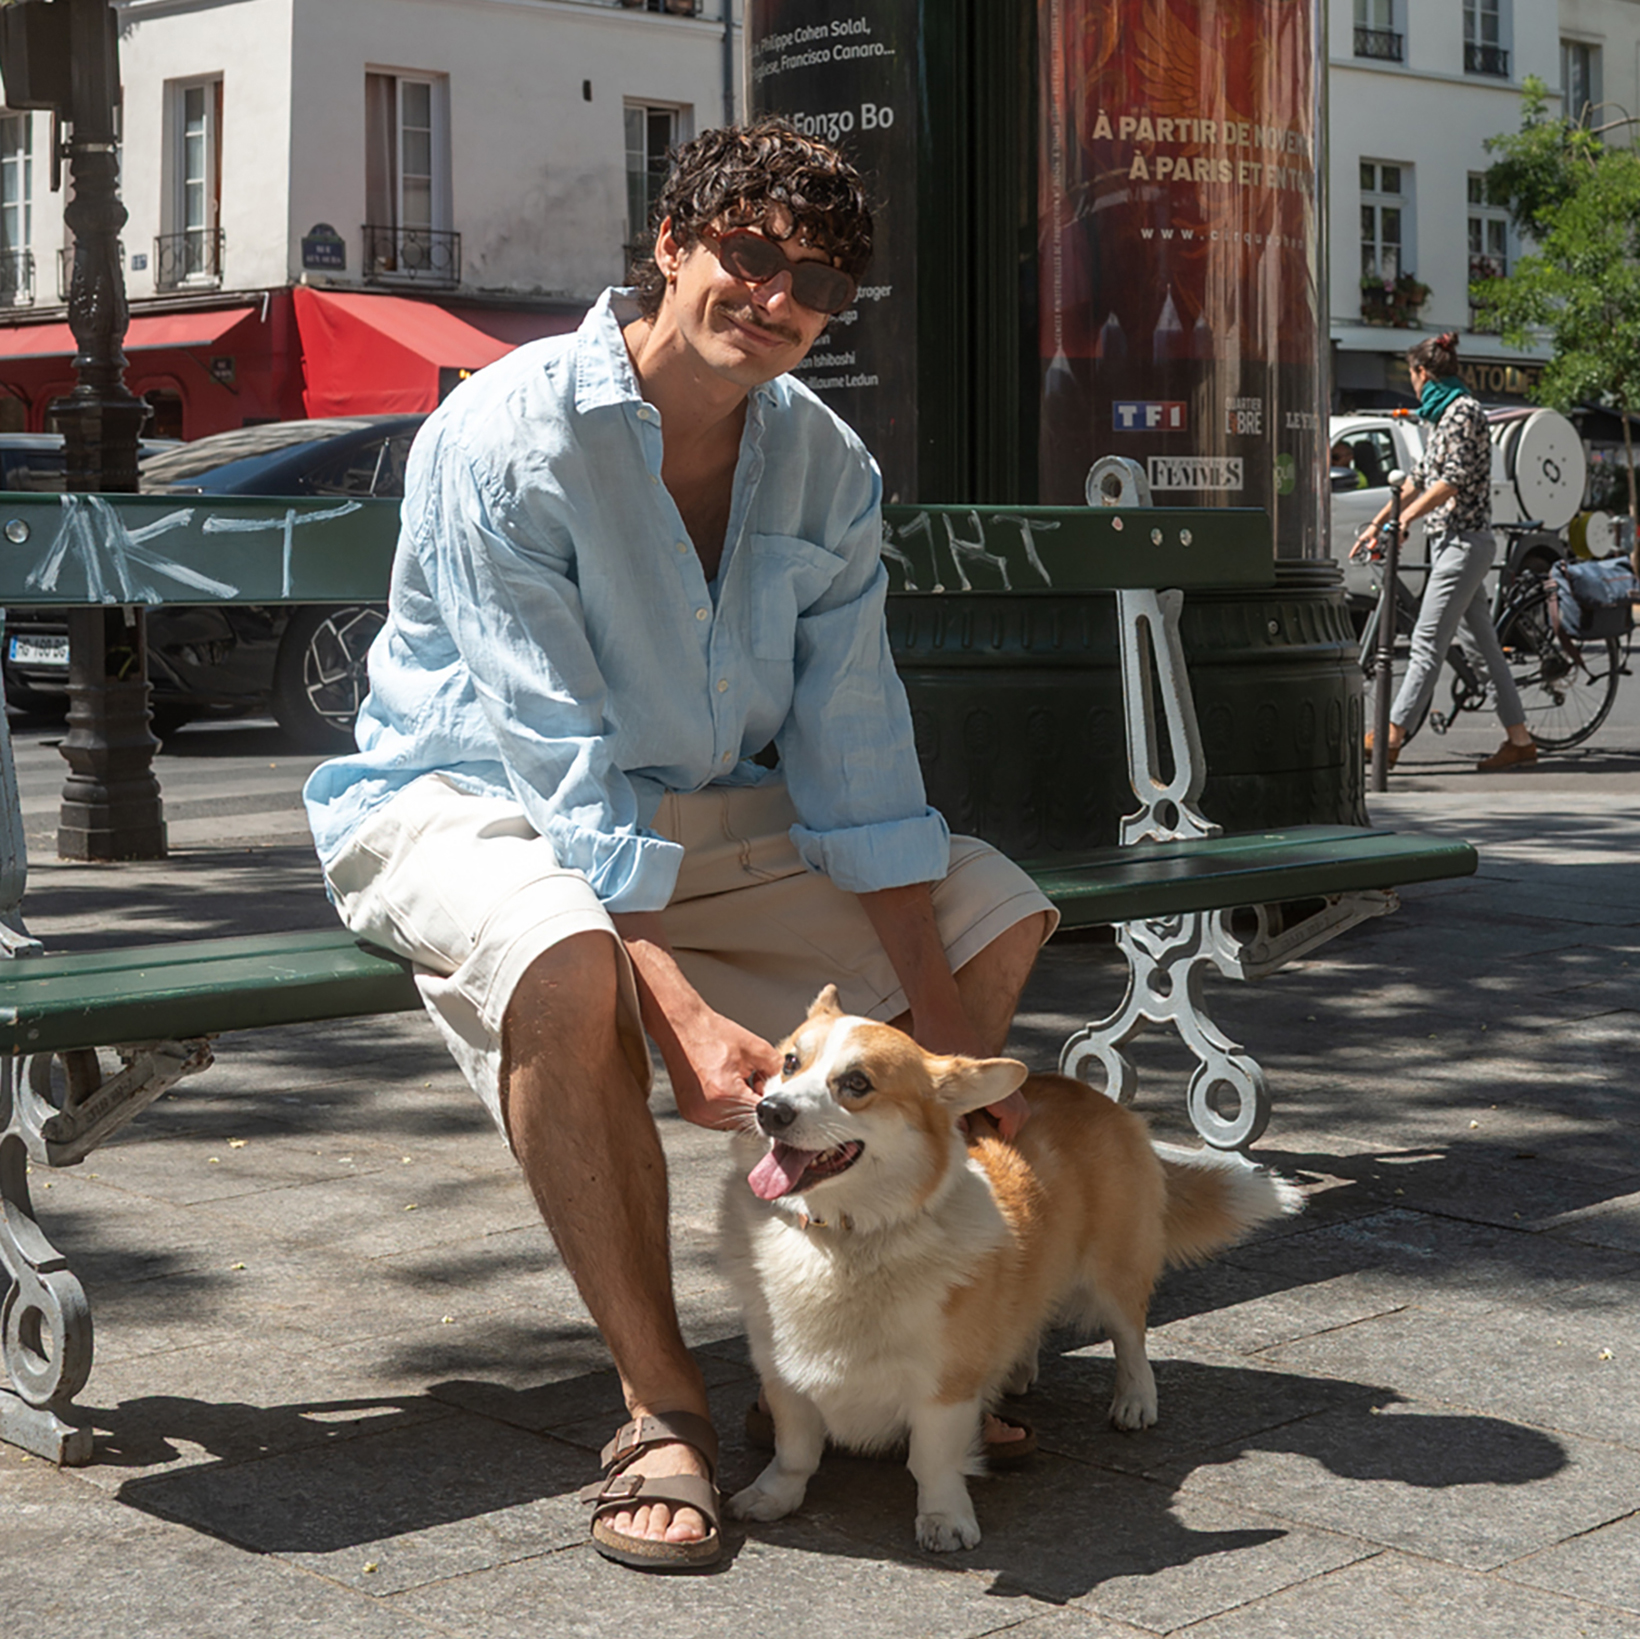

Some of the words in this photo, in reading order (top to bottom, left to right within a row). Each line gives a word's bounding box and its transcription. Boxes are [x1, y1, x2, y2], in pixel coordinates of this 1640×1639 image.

[794, 24, 828, 44] Cohen
[831, 17, 871, 36] Solal,
[781, 49, 831, 70] Francisco
[832, 43, 895, 61] Canaro...
[794, 110, 854, 142] Fonzo
[861, 103, 894, 130] Bo
[1092, 109, 1113, 140] À
[1119, 116, 1217, 144] PARTIR
[1224, 120, 1250, 148] DE
[1128, 150, 1149, 180] À
[1156, 156, 1233, 183] PARIS
[1238, 160, 1262, 186] ET
[1266, 164, 1286, 190] EN
[845, 373, 879, 388] Ledun
[1118, 404, 1181, 428] TF1
[1152, 460, 1241, 487] FEMMES
